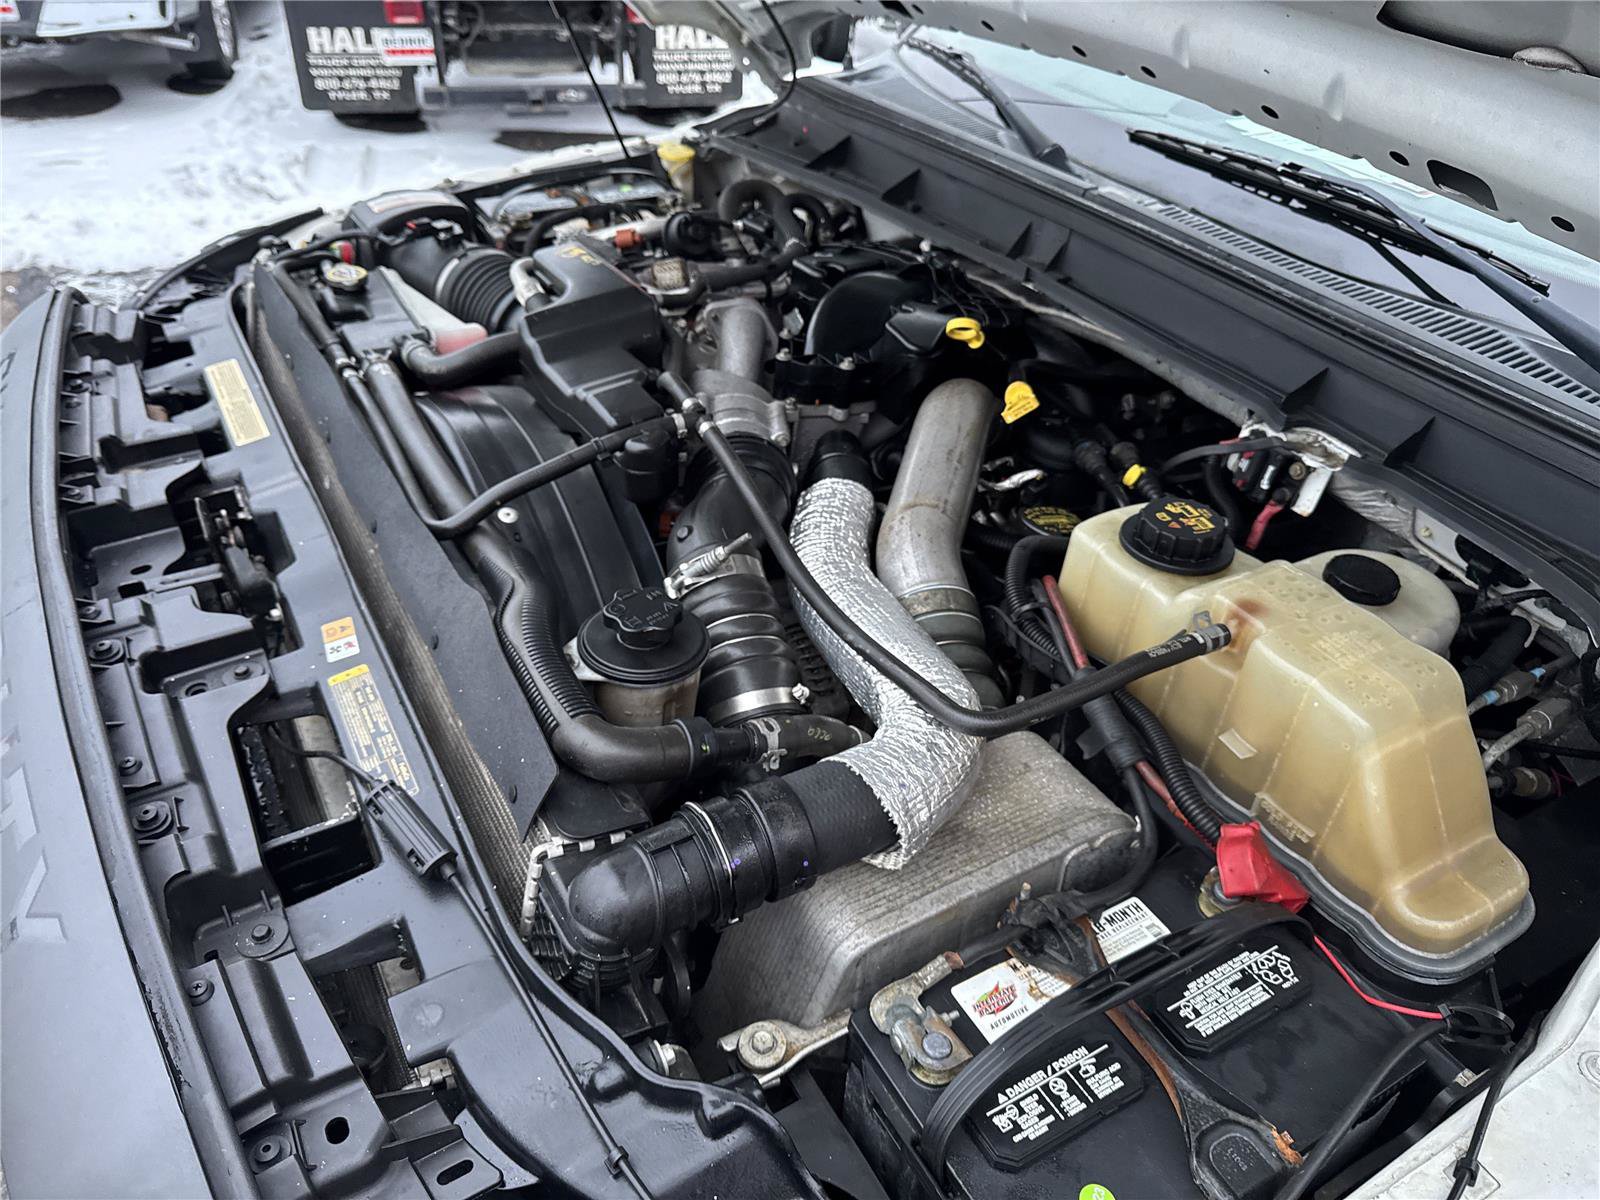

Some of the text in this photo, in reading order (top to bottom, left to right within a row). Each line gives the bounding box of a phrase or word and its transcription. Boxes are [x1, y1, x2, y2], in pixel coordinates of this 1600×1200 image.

[971, 983, 1015, 1011] INTERSTATE
[977, 991, 1017, 1016] BATTERIES
[989, 1005, 1028, 1029] AUTOMOTIVE
[1005, 1069, 1047, 1098] DANGER
[1052, 1045, 1088, 1071] POISON
